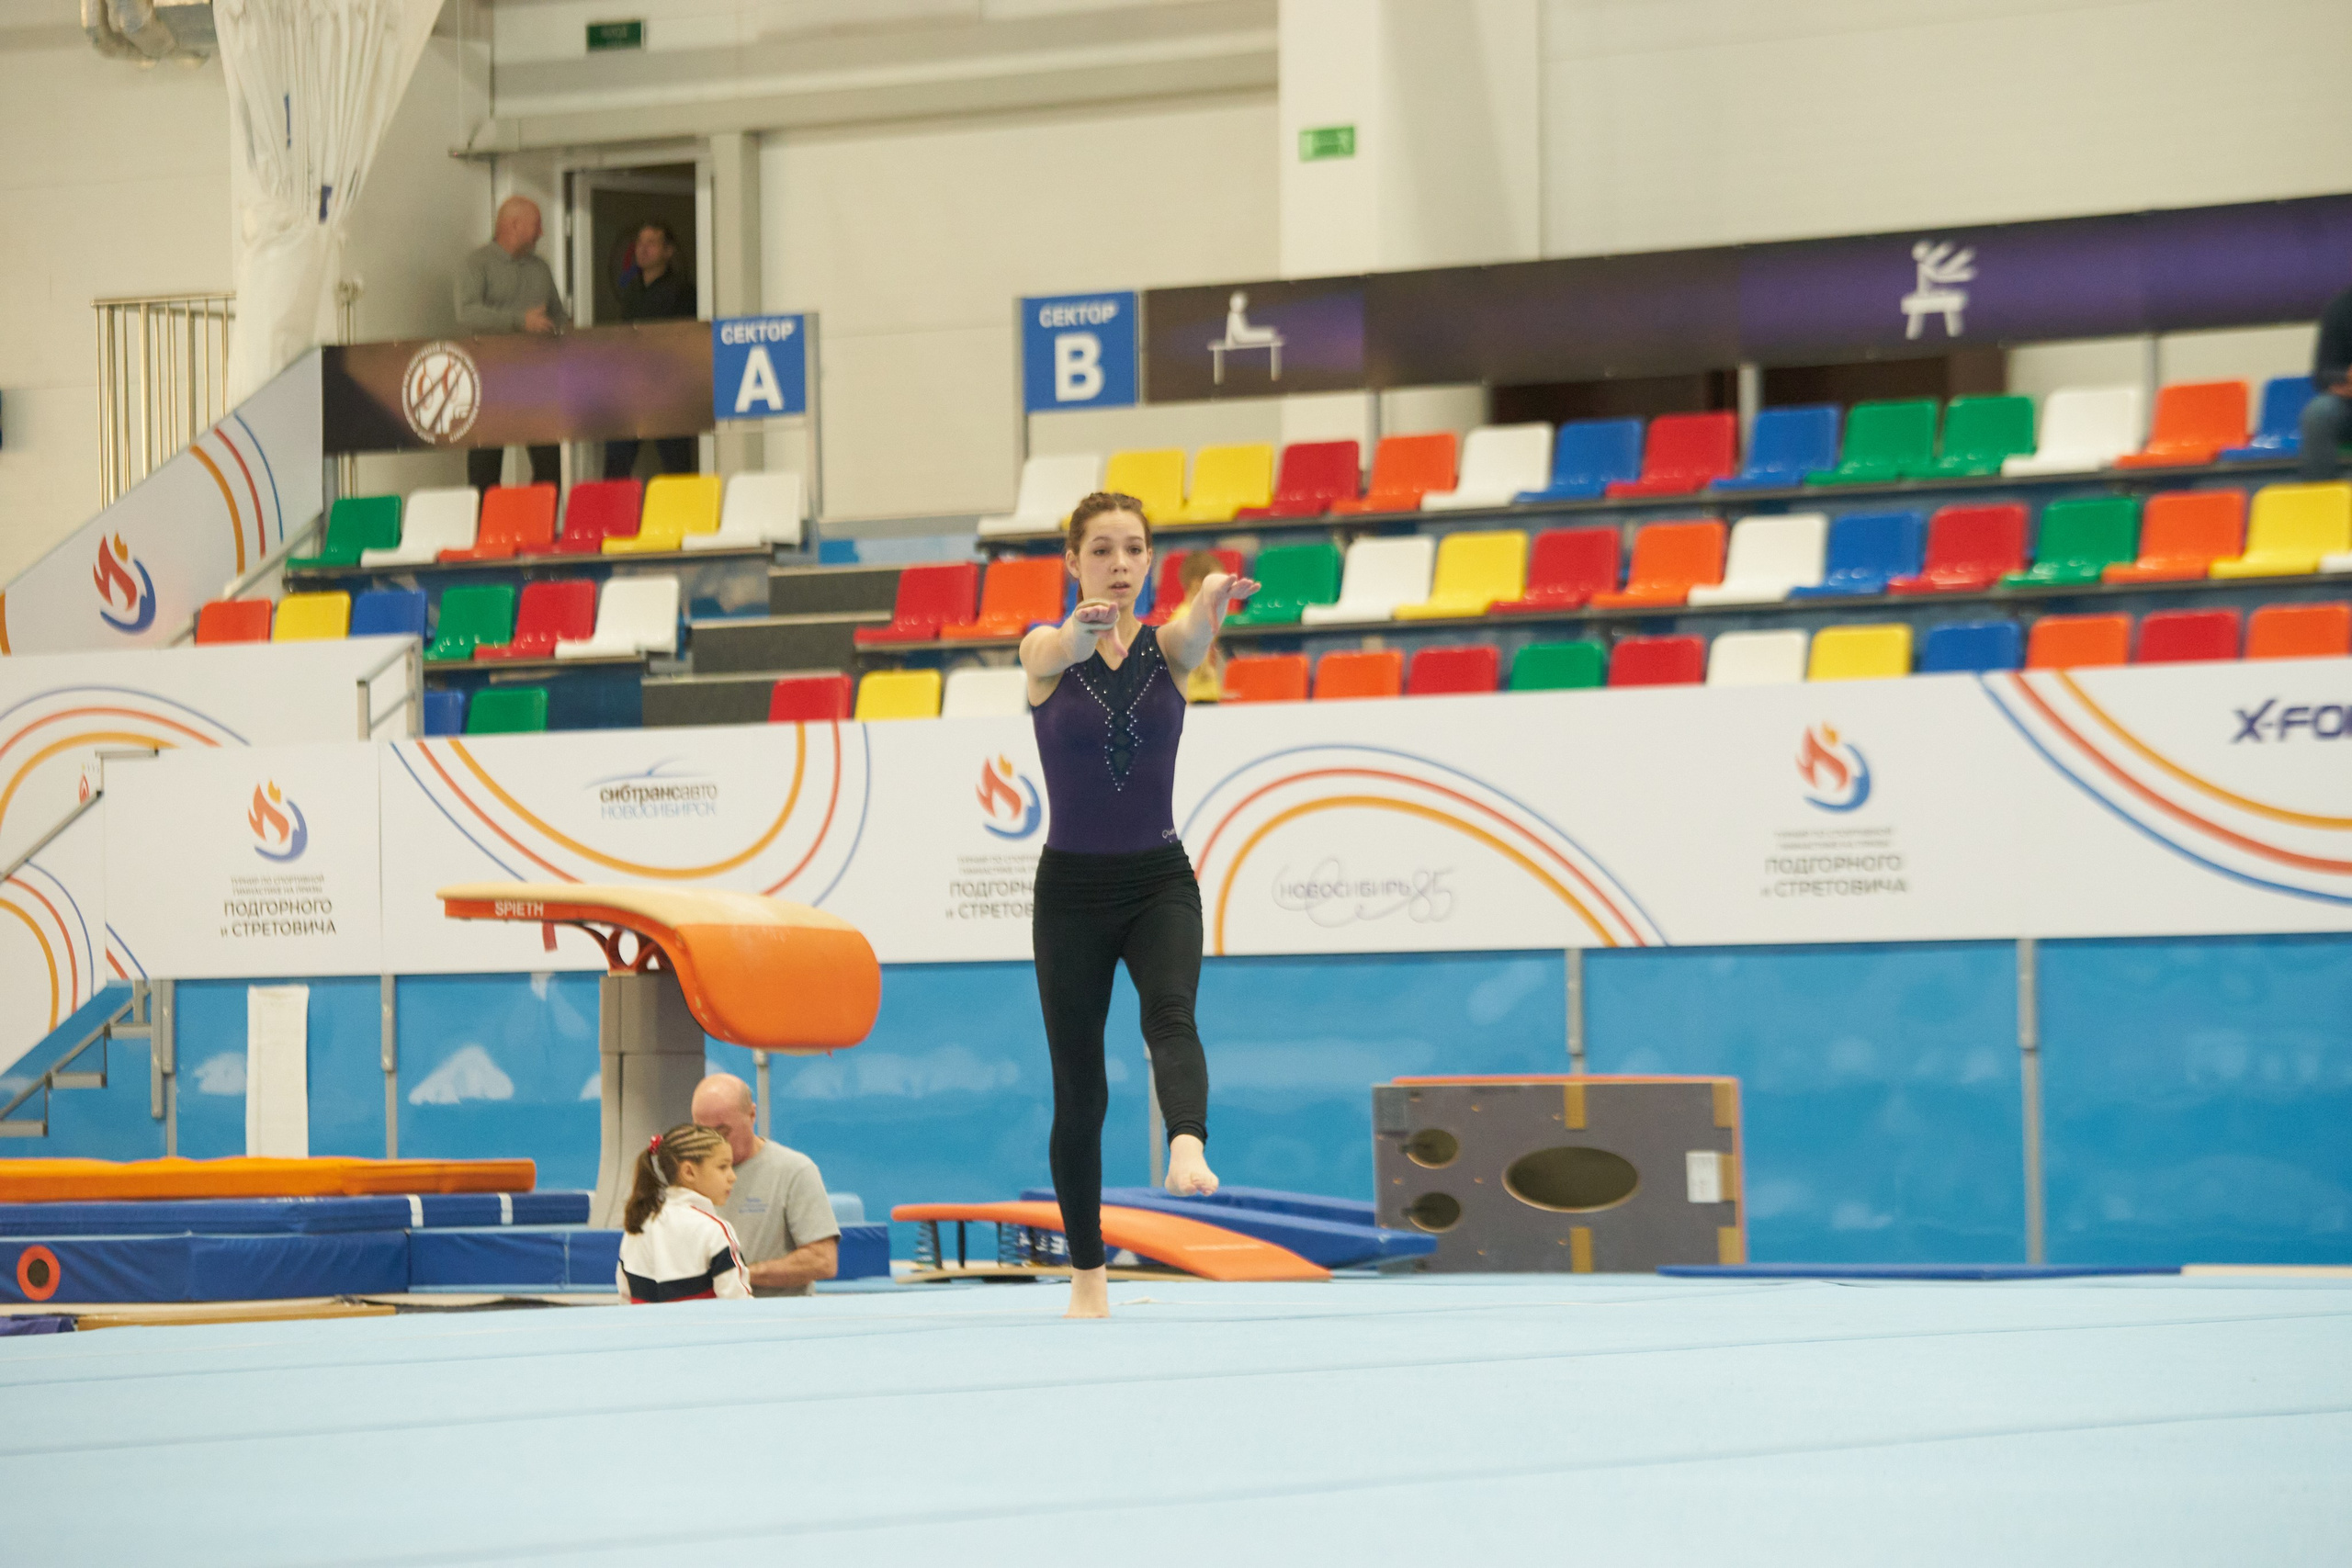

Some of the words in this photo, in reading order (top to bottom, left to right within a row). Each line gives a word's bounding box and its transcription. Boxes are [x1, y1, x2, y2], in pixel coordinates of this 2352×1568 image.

[1039, 300, 1118, 328] СЕКТОР
[720, 319, 795, 345] СЕКТОР
[599, 783, 718, 806] сибтрансавто
[1765, 855, 1903, 874] ПОДГОРНОГО
[950, 881, 1034, 899] ПОДГОРН
[1774, 878, 1907, 897] СТРЕТОВИЧА
[223, 898, 333, 919] ПОДГОРНОГО
[494, 900, 544, 917] SPIETH
[958, 902, 1034, 919] СТРЕТОВ
[232, 919, 336, 937] СТРЕТОВИЧА
